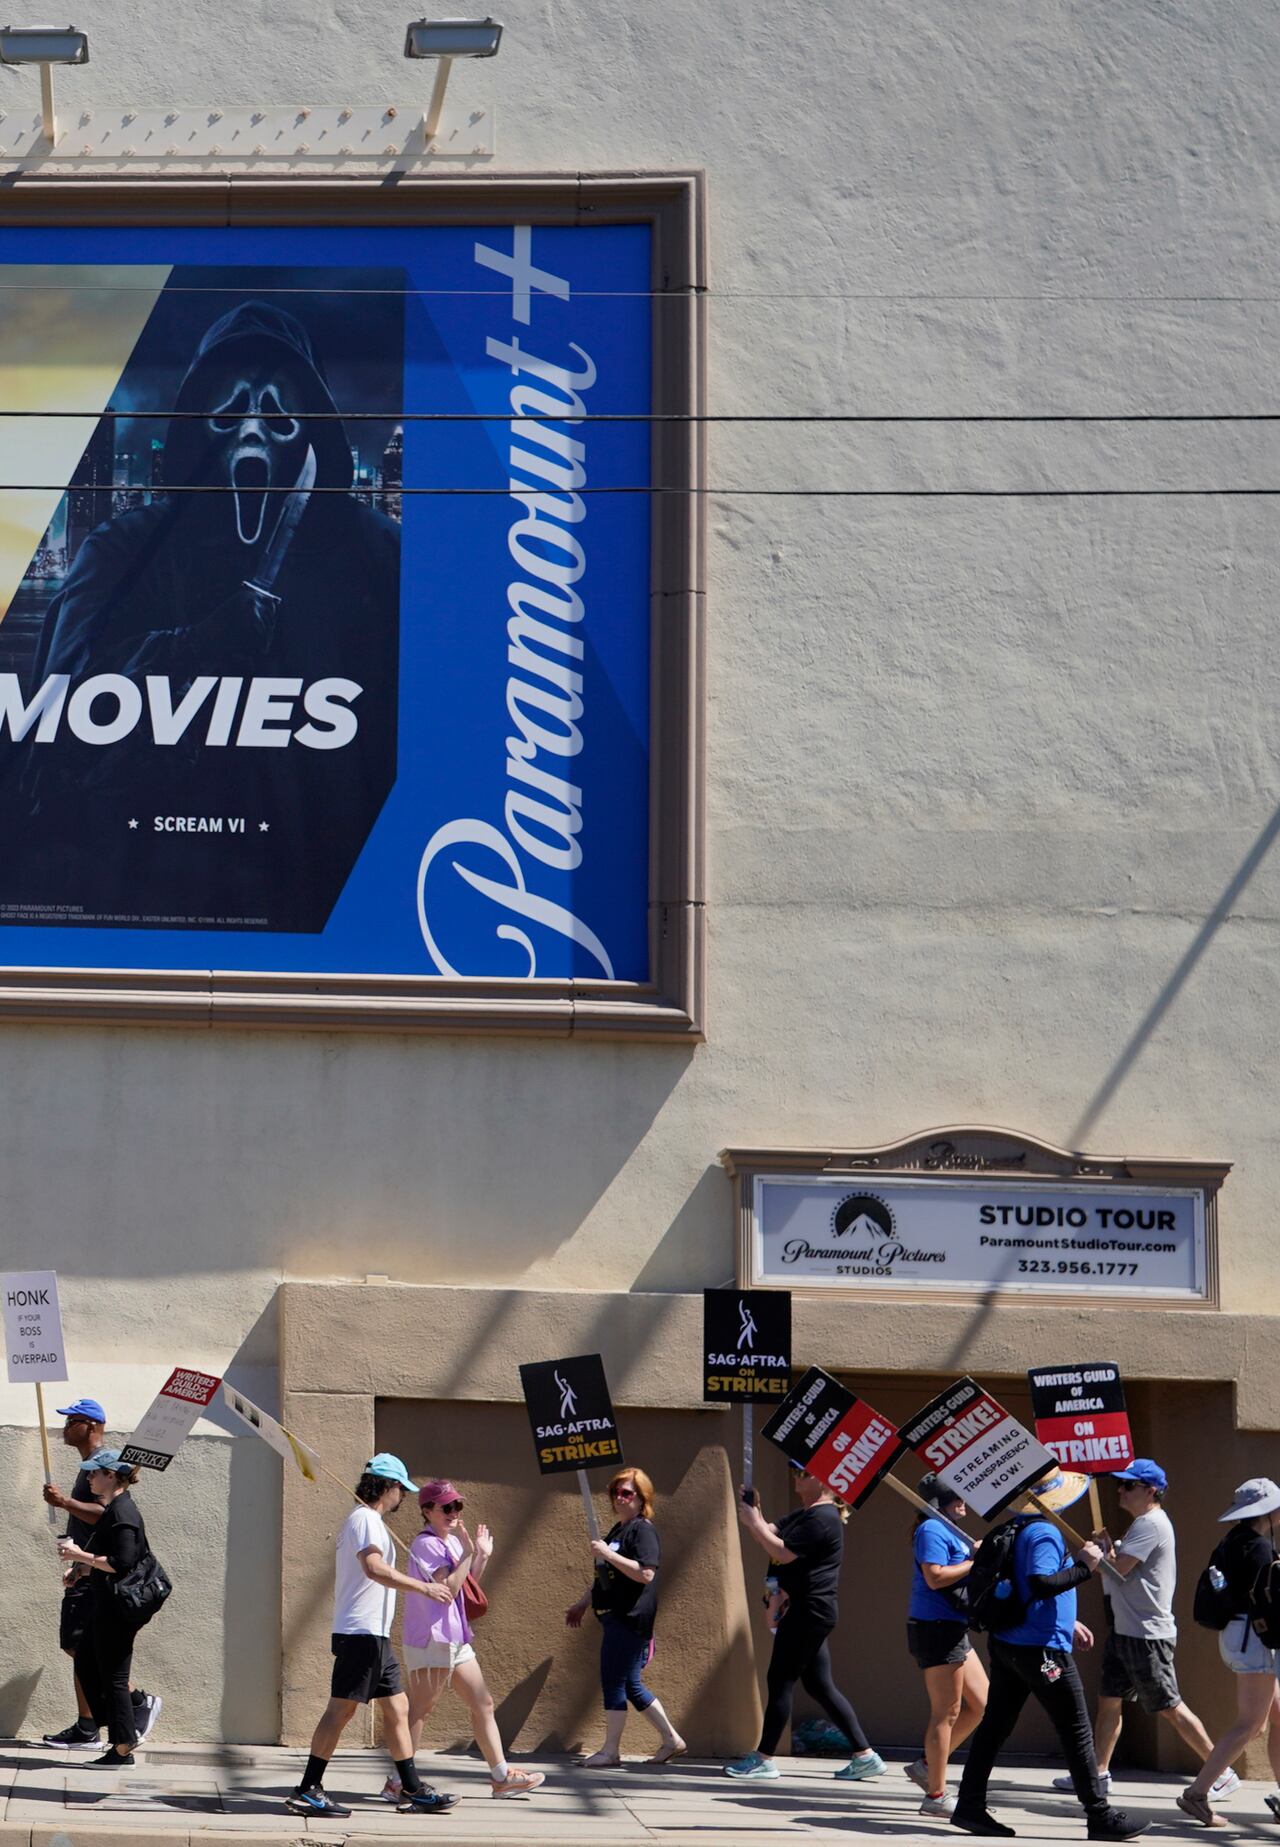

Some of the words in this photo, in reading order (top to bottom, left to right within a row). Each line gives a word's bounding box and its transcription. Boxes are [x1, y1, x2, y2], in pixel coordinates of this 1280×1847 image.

[153, 816, 223, 833] SCREAM
[227, 818, 245, 833] VI
[979, 1205, 1088, 1228] STUDIO
[1095, 1208, 1176, 1231] TOUR
[781, 1239, 874, 1264] Paramount
[875, 1242, 946, 1267] Pictures
[836, 1265, 893, 1276] STUDIOS
[1018, 1259, 1139, 1276] 323.956.1777
[7, 1289, 50, 1306] HONK
[20, 1326, 42, 1336] BOSS
[12, 1353, 58, 1365] OVERPAID
[176, 1371, 216, 1387] WRITERS
[739, 1368, 755, 1377] ON
[1033, 1372, 1082, 1388] WRITERS
[1083, 1369, 1116, 1383] GUILD
[164, 1385, 208, 1402] AMERICA
[172, 1378, 200, 1392] GUILD
[707, 1376, 788, 1394] STRIKE!
[1070, 1386, 1083, 1397] OF
[773, 1401, 808, 1443] WRITERS
[802, 1377, 827, 1406] GUILD
[1055, 1397, 1104, 1413] AMERICA
[804, 1412, 817, 1425] OF
[906, 1405, 950, 1443] WRITERS
[946, 1385, 976, 1410] GUILD
[943, 1415, 956, 1427] ON
[804, 1407, 840, 1449] AMERICA
[924, 1400, 1002, 1467] STRIKE!
[1074, 1421, 1095, 1436] ON
[568, 1434, 584, 1444] ON
[832, 1431, 853, 1452] ON
[540, 1439, 618, 1464] STRIKE!
[827, 1418, 892, 1494] STRIKE!
[953, 1429, 1020, 1483] STREAMING
[1044, 1434, 1130, 1464] STRIKE!
[123, 1448, 170, 1468] STRIKE
[963, 1438, 1030, 1493] TRANSPARENCY
[991, 1461, 1024, 1489] NOW!
